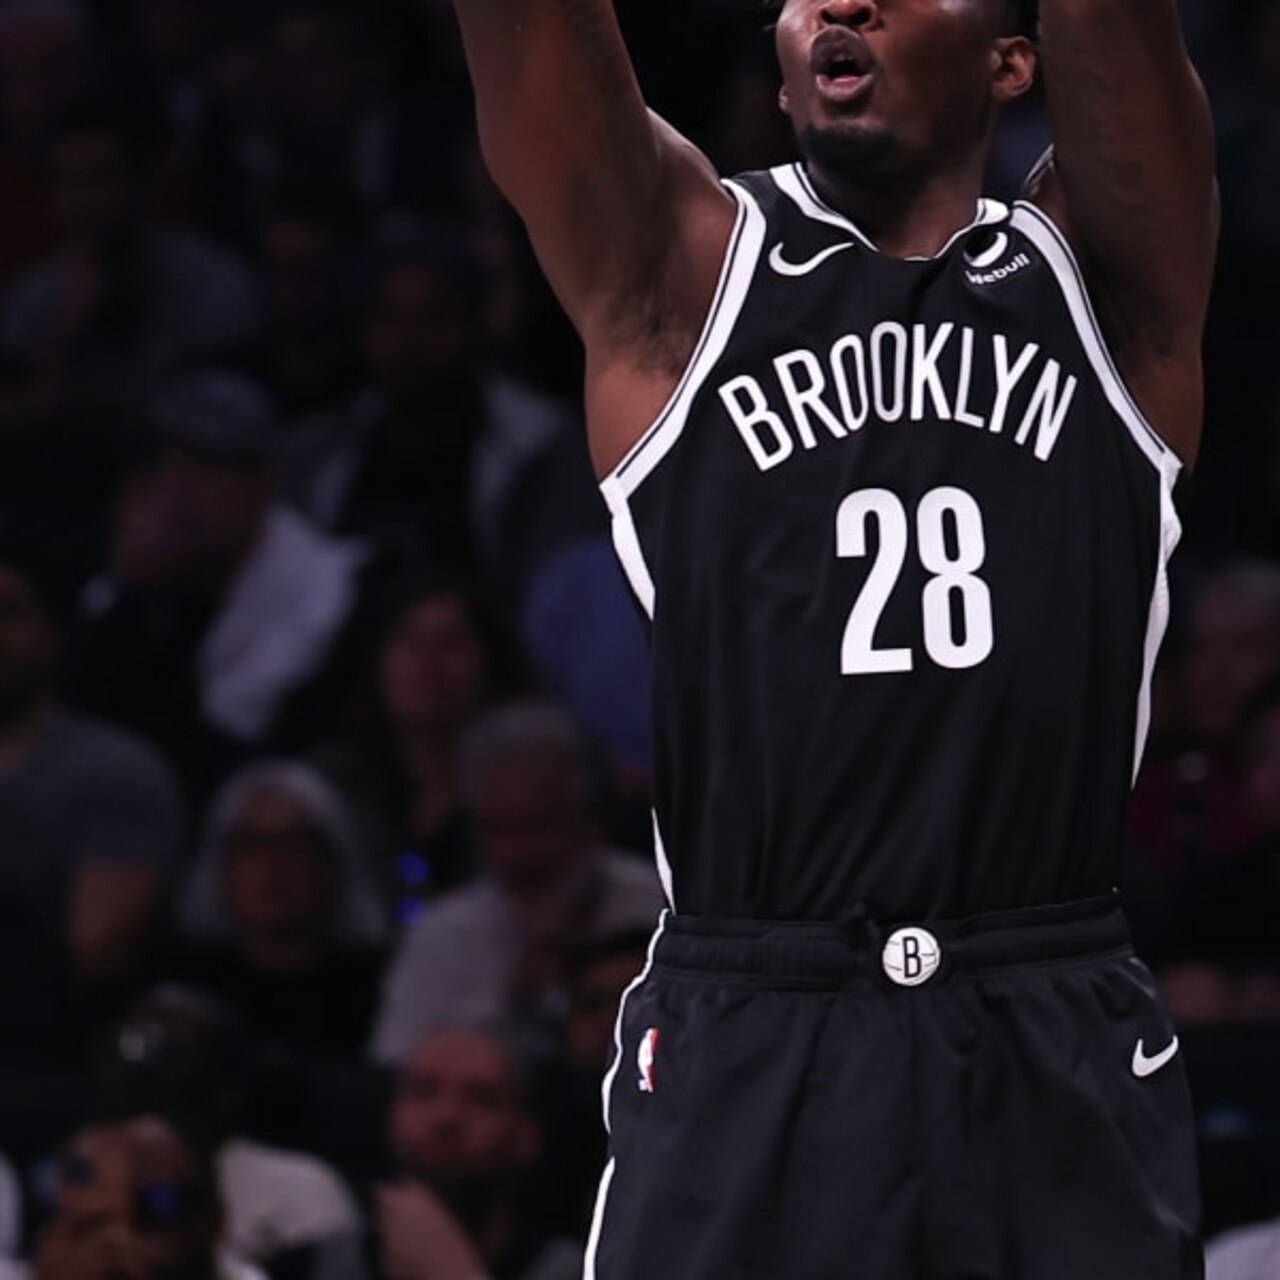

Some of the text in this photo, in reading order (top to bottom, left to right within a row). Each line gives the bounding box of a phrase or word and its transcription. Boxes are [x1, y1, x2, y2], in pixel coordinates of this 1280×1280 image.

[717, 321, 1078, 471] BROOKLYN
[834, 485, 995, 676] 28
[903, 936, 922, 978] B
